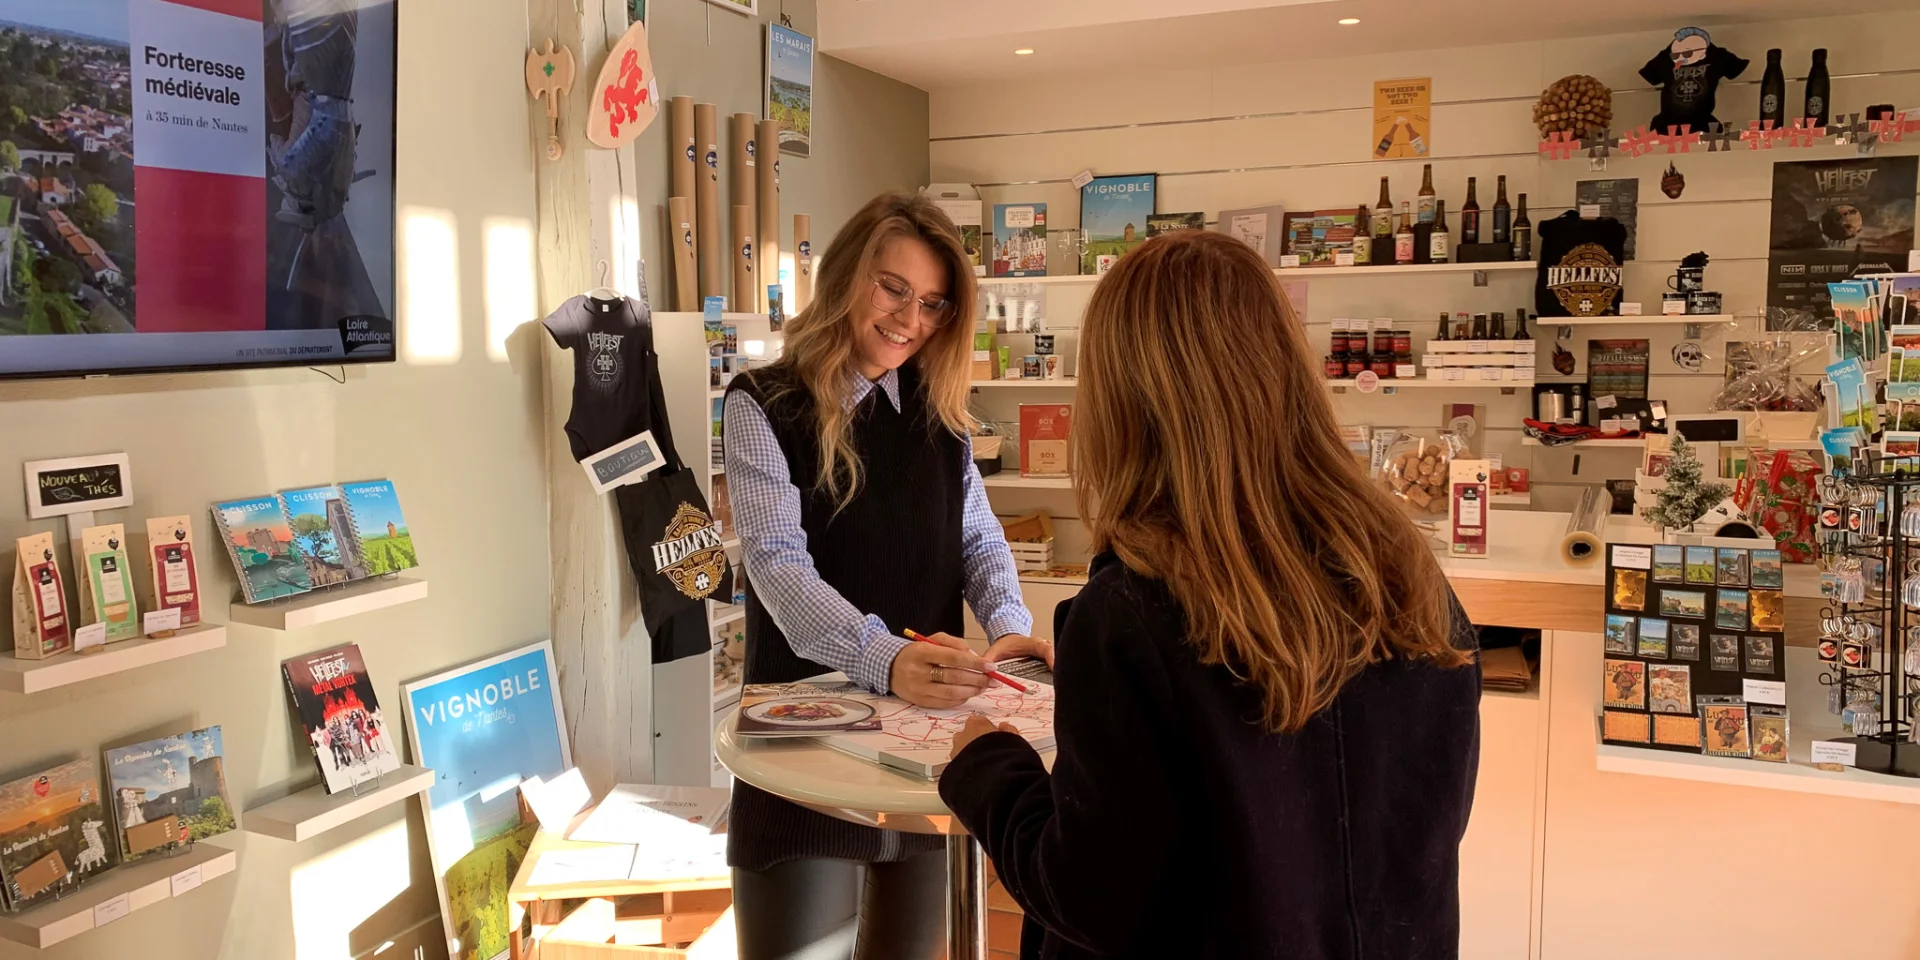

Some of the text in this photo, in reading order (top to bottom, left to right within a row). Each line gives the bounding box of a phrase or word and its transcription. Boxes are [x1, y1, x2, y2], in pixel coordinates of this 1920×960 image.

[786, 37, 811, 53] MARAIS
[144, 45, 246, 81] Forteresse
[145, 77, 241, 106] médiévale
[146, 109, 248, 134] à 35 min de Nantes
[1086, 182, 1151, 194] VIGNOBLE
[1814, 167, 1878, 193] HELLFEST
[1547, 266, 1623, 289] HELLFEST
[346, 319, 368, 330] Loire
[346, 331, 391, 344] Atlantique
[587, 331, 625, 353] HELLFEST
[1829, 364, 1858, 378] VIGNOBLE
[598, 447, 649, 478] BOUTIQUE
[292, 491, 332, 502] CLISSON
[352, 485, 388, 494] VIGNOBLE
[229, 502, 272, 513] CLISSON
[651, 526, 722, 574] HELLFES
[311, 674, 357, 695] METAL VORTEX
[420, 668, 540, 726] VIGNOBLE
[462, 706, 508, 733] de Nantes
